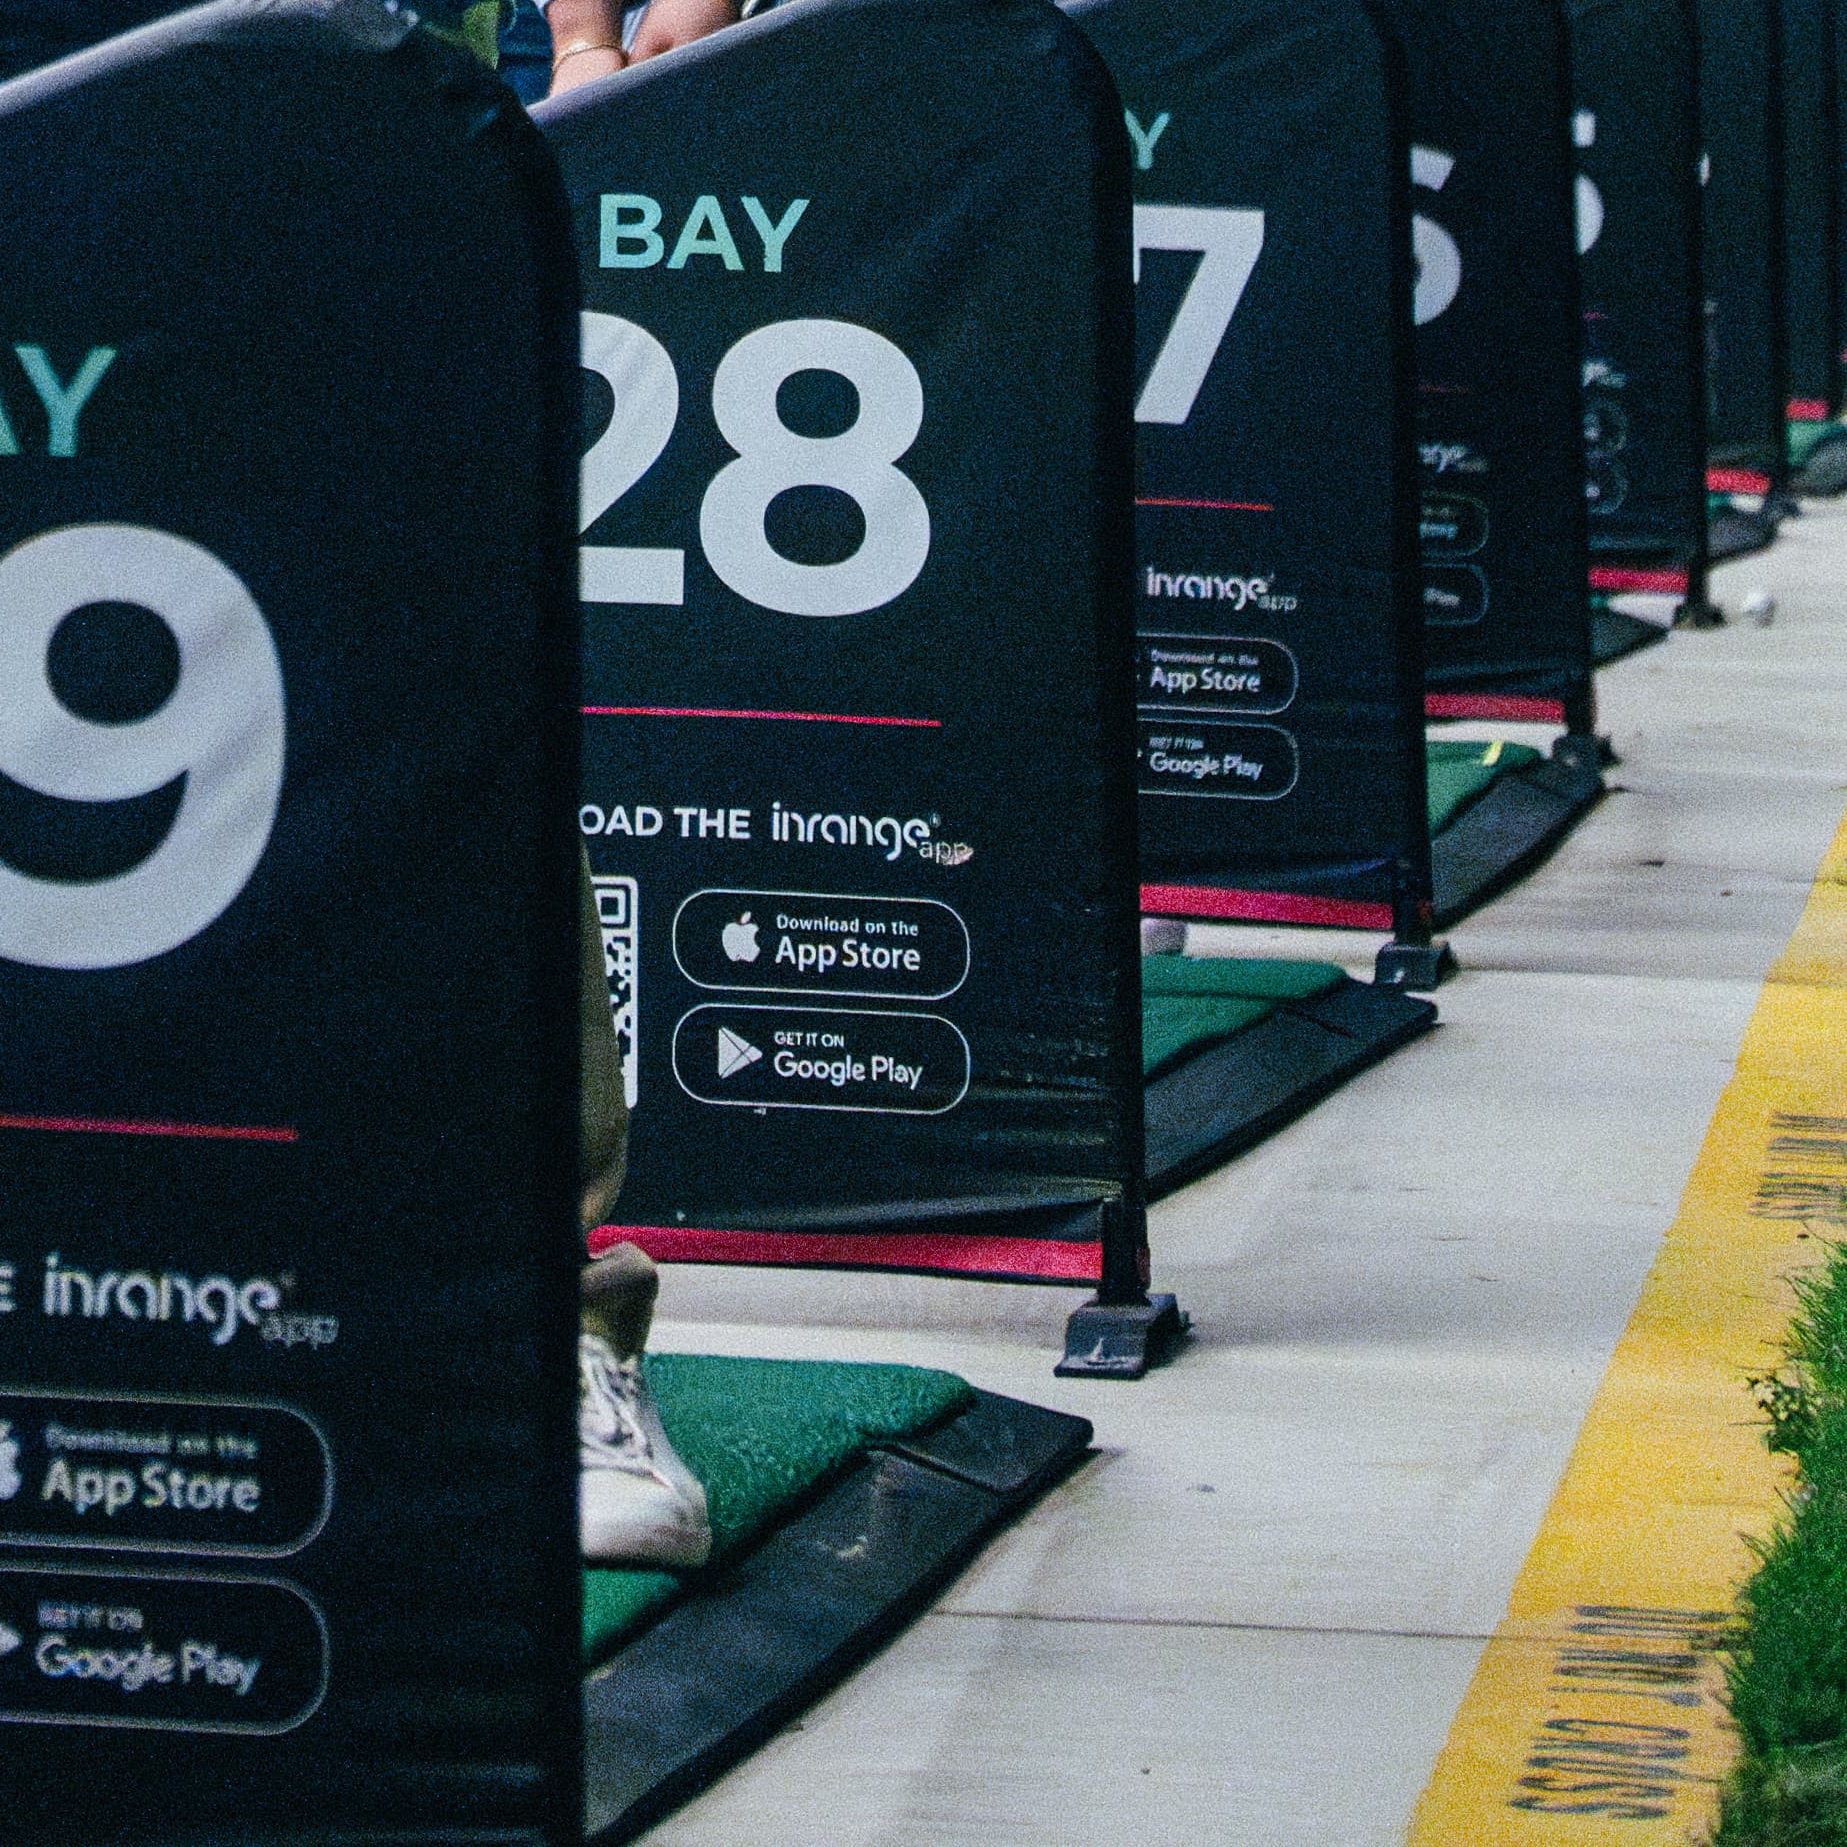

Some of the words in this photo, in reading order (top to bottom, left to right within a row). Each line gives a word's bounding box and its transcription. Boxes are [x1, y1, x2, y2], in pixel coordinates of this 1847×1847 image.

[598, 193, 811, 273] BAY
[578, 310, 931, 618] 28
[1150, 666, 1197, 693] App
[1201, 667, 1260, 692] Store
[1149, 751, 1220, 779] Google
[674, 808, 751, 840] THE
[776, 914, 860, 934] Download
[865, 922, 885, 934] on
[891, 920, 919, 937] the
[775, 935, 837, 973] App
[842, 938, 921, 971] Store
[774, 1030, 803, 1046] GET
[806, 1032, 817, 1047] IT
[821, 1033, 844, 1048] ON
[774, 1051, 865, 1087] Google
[871, 1055, 923, 1091] Play
[41, 1457, 136, 1516] App
[141, 1459, 261, 1513] Store
[35, 1633, 176, 1692] Google
[181, 1639, 263, 1697] Play
